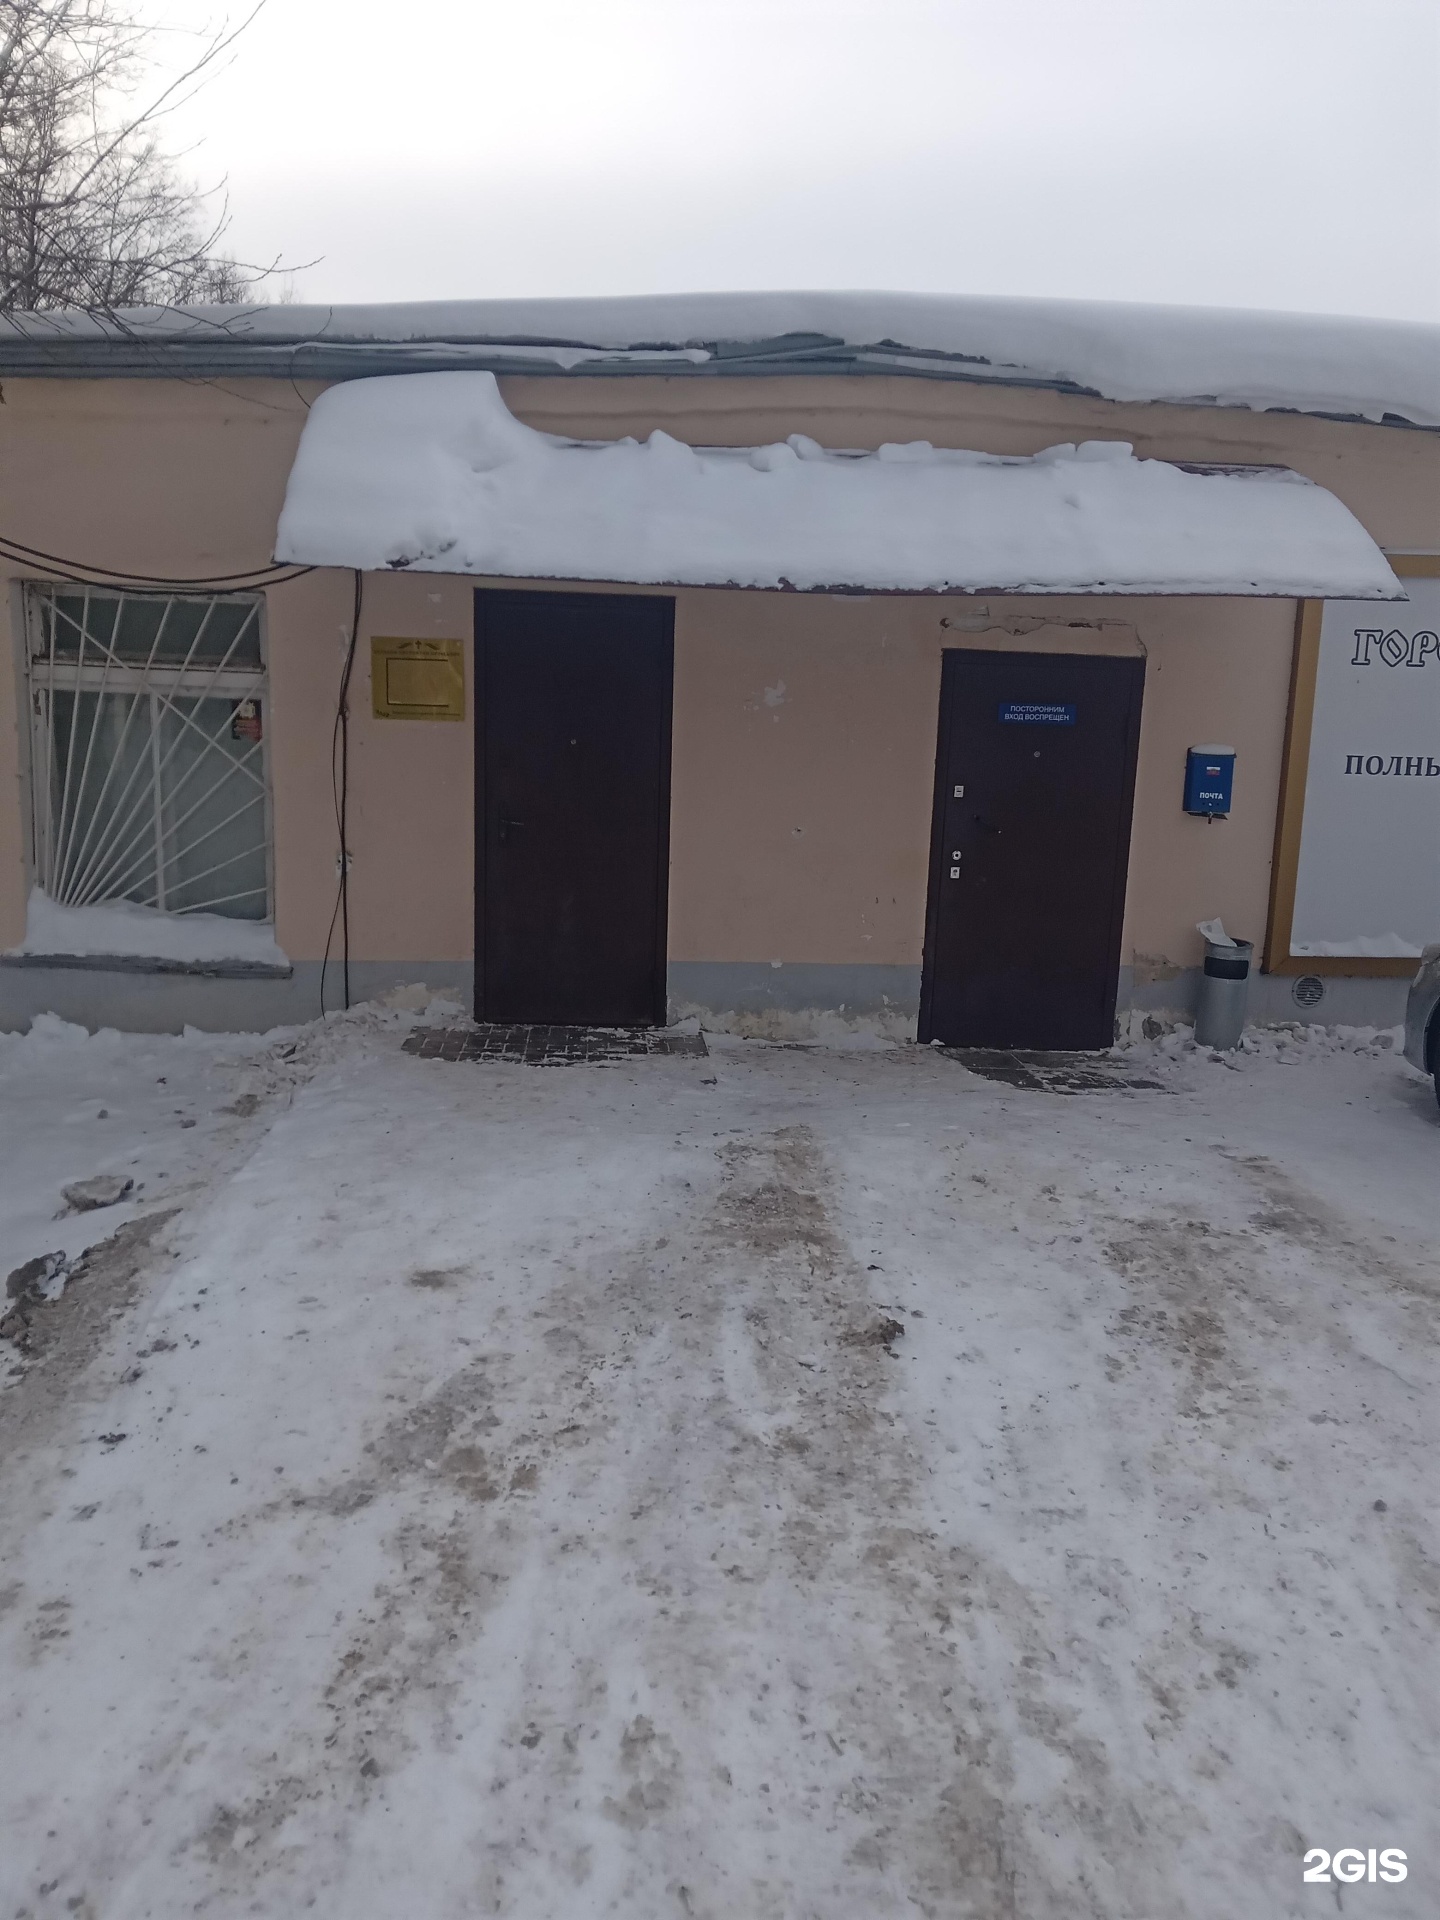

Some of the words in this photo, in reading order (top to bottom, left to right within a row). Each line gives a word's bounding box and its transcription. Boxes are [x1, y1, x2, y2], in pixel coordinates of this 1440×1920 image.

[1351, 629, 1440, 667] ГОР
[1010, 705, 1065, 713] ПОСТОРОННИМ
[1004, 713, 1024, 721] ВХОД
[1024, 713, 1070, 722] ВОСПРЕЩЕН
[1199, 792, 1224, 800] ПОЧТА
